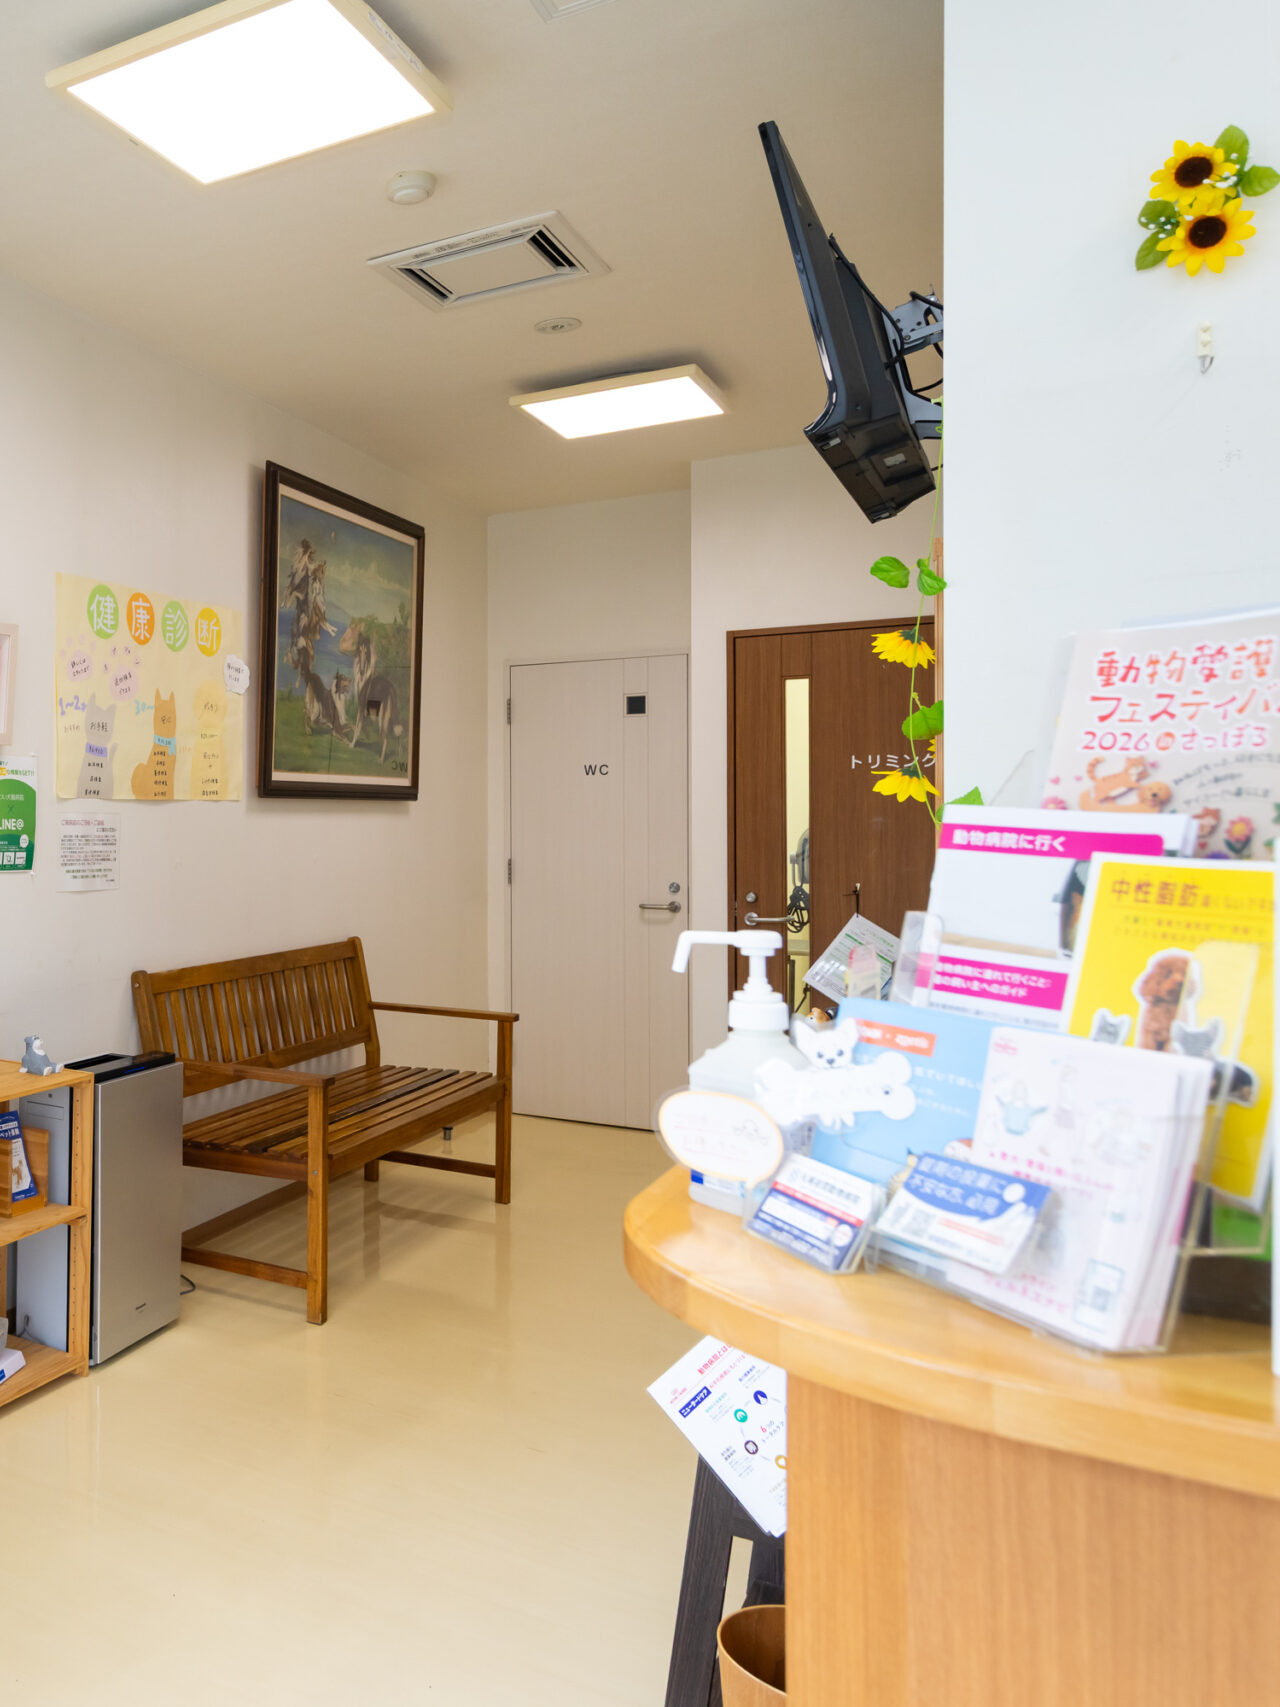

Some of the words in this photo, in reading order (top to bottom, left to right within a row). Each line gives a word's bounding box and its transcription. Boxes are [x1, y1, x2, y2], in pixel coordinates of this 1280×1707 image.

[90, 594, 219, 652] 健康診断
[1097, 638, 1273, 688] 動物愛護
[1089, 688, 1280, 723] フェスティバ
[584, 764, 609, 776] WC
[951, 828, 1067, 853] 動物病院に行く
